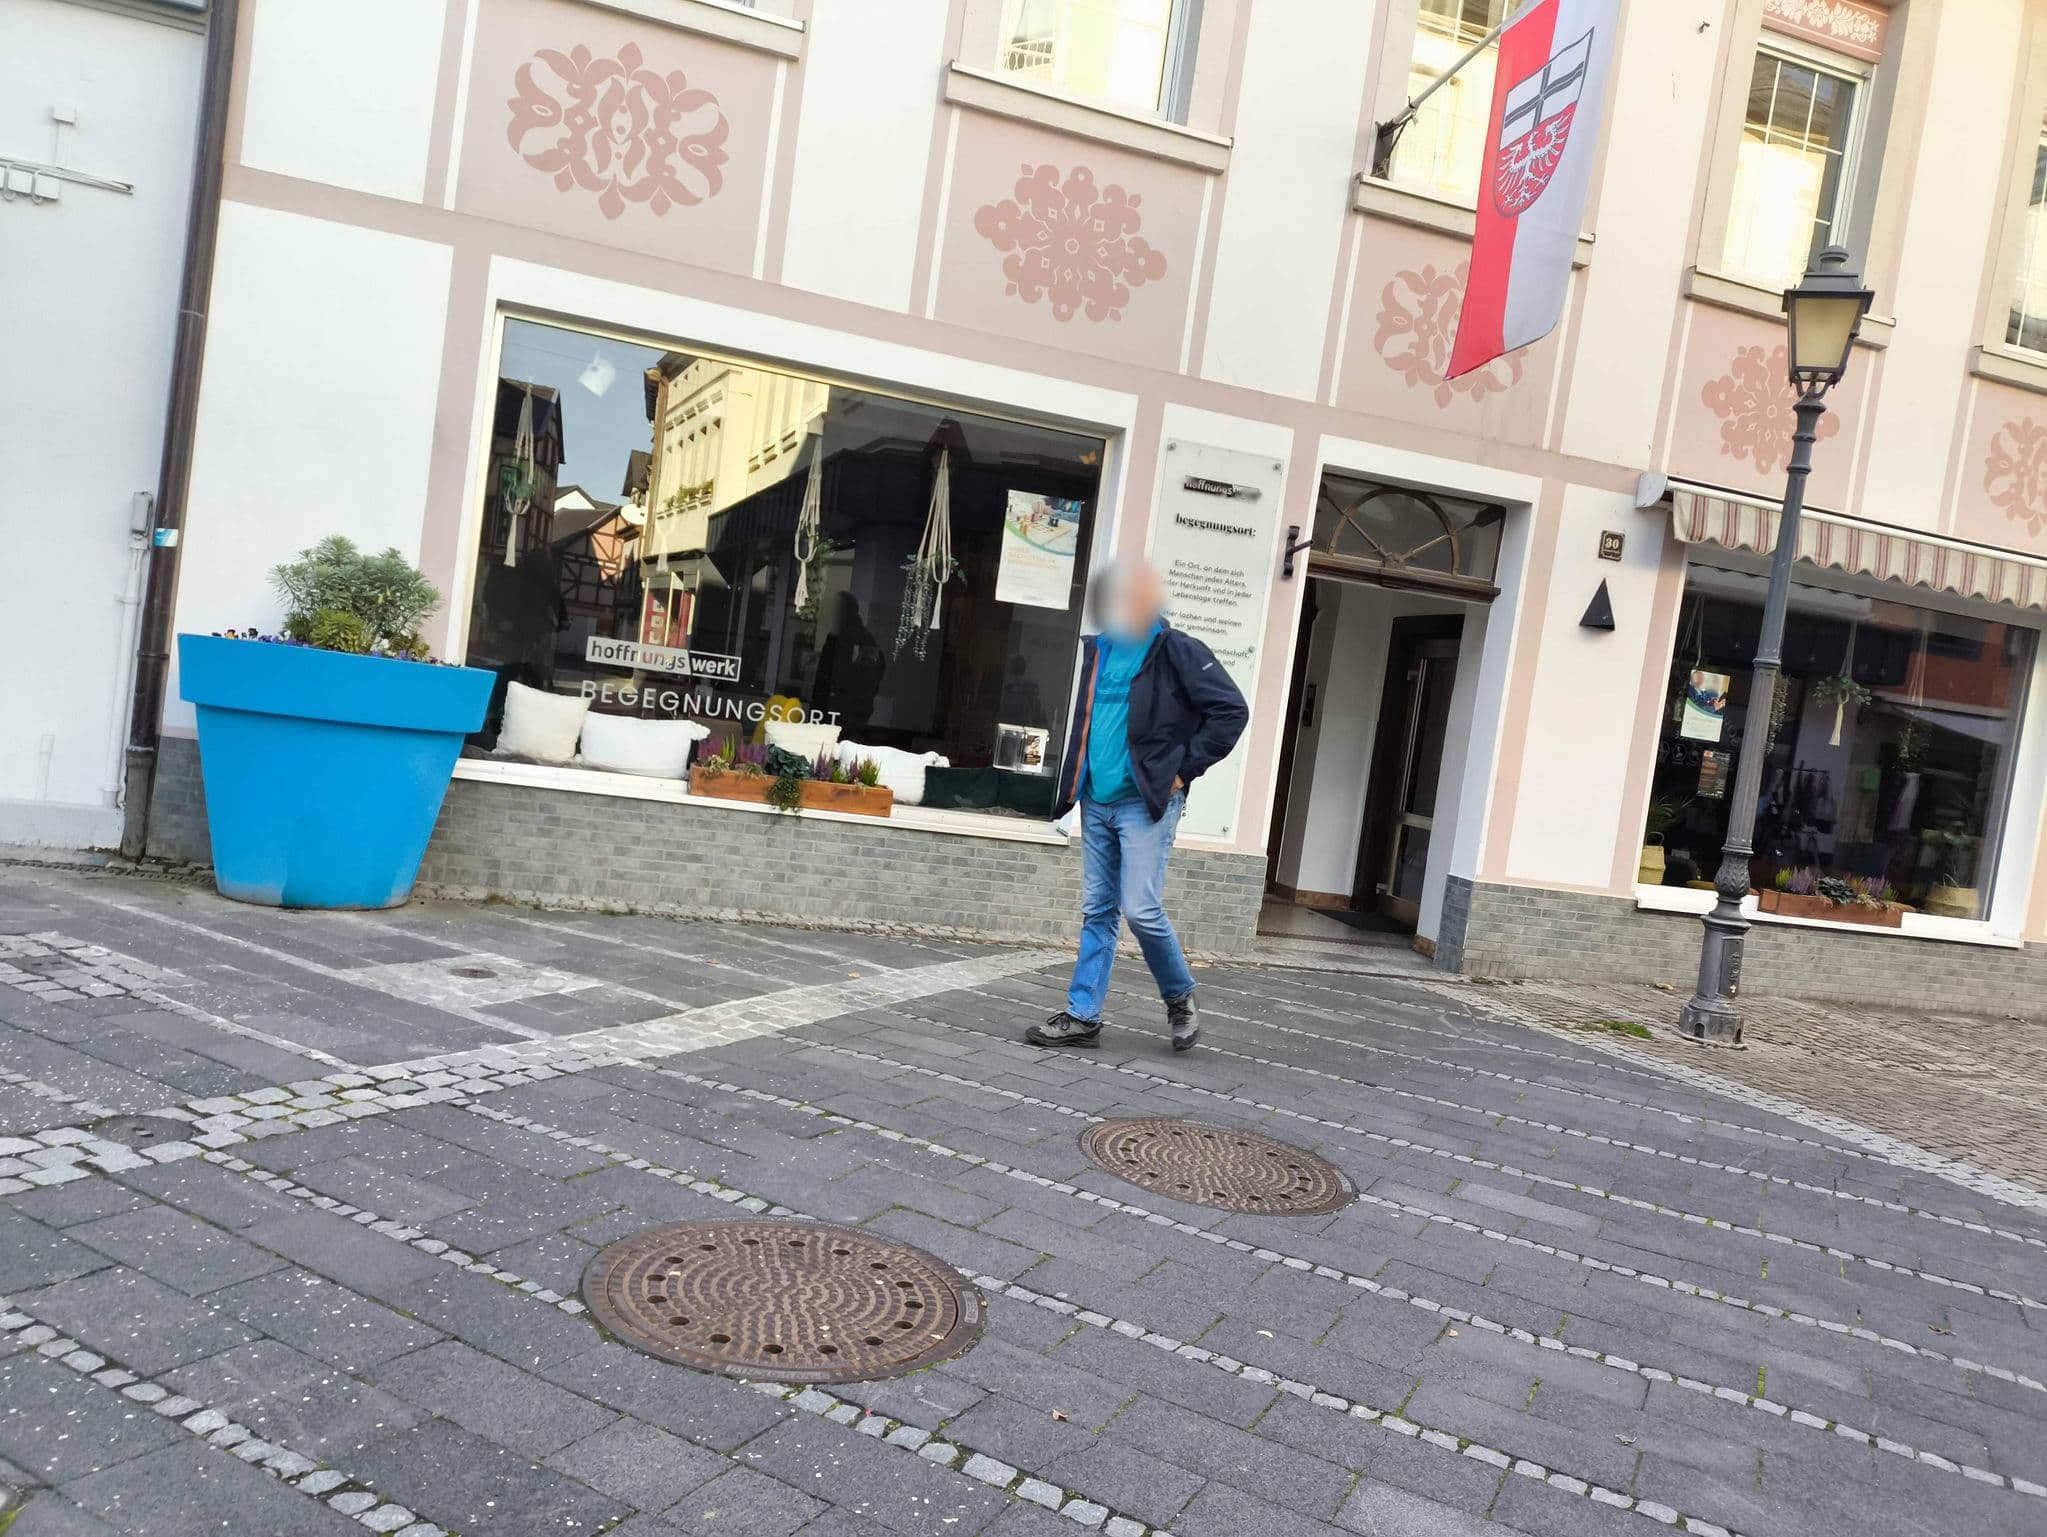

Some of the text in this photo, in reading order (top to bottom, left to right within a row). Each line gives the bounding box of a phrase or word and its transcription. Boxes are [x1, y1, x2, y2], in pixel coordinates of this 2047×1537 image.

[1176, 513, 1256, 537] begegnungsort:
[1605, 537, 1620, 549] 30
[1169, 569, 1203, 581] Menschen
[1204, 575, 1223, 585] jedes
[1175, 560, 1186, 568] Ein
[1214, 565, 1229, 575] dem
[1231, 568, 1244, 577] sich
[1172, 590, 1211, 603] Lebenslage
[1180, 581, 1211, 592] Herkunft
[1226, 588, 1233, 596] in
[1234, 589, 1252, 599] jeder
[1174, 621, 1185, 629] wir
[1180, 610, 1202, 620] lachen
[1204, 615, 1216, 623] und
[1219, 618, 1242, 627] weinen
[580, 679, 841, 727] BEGEGNUNGSORT
